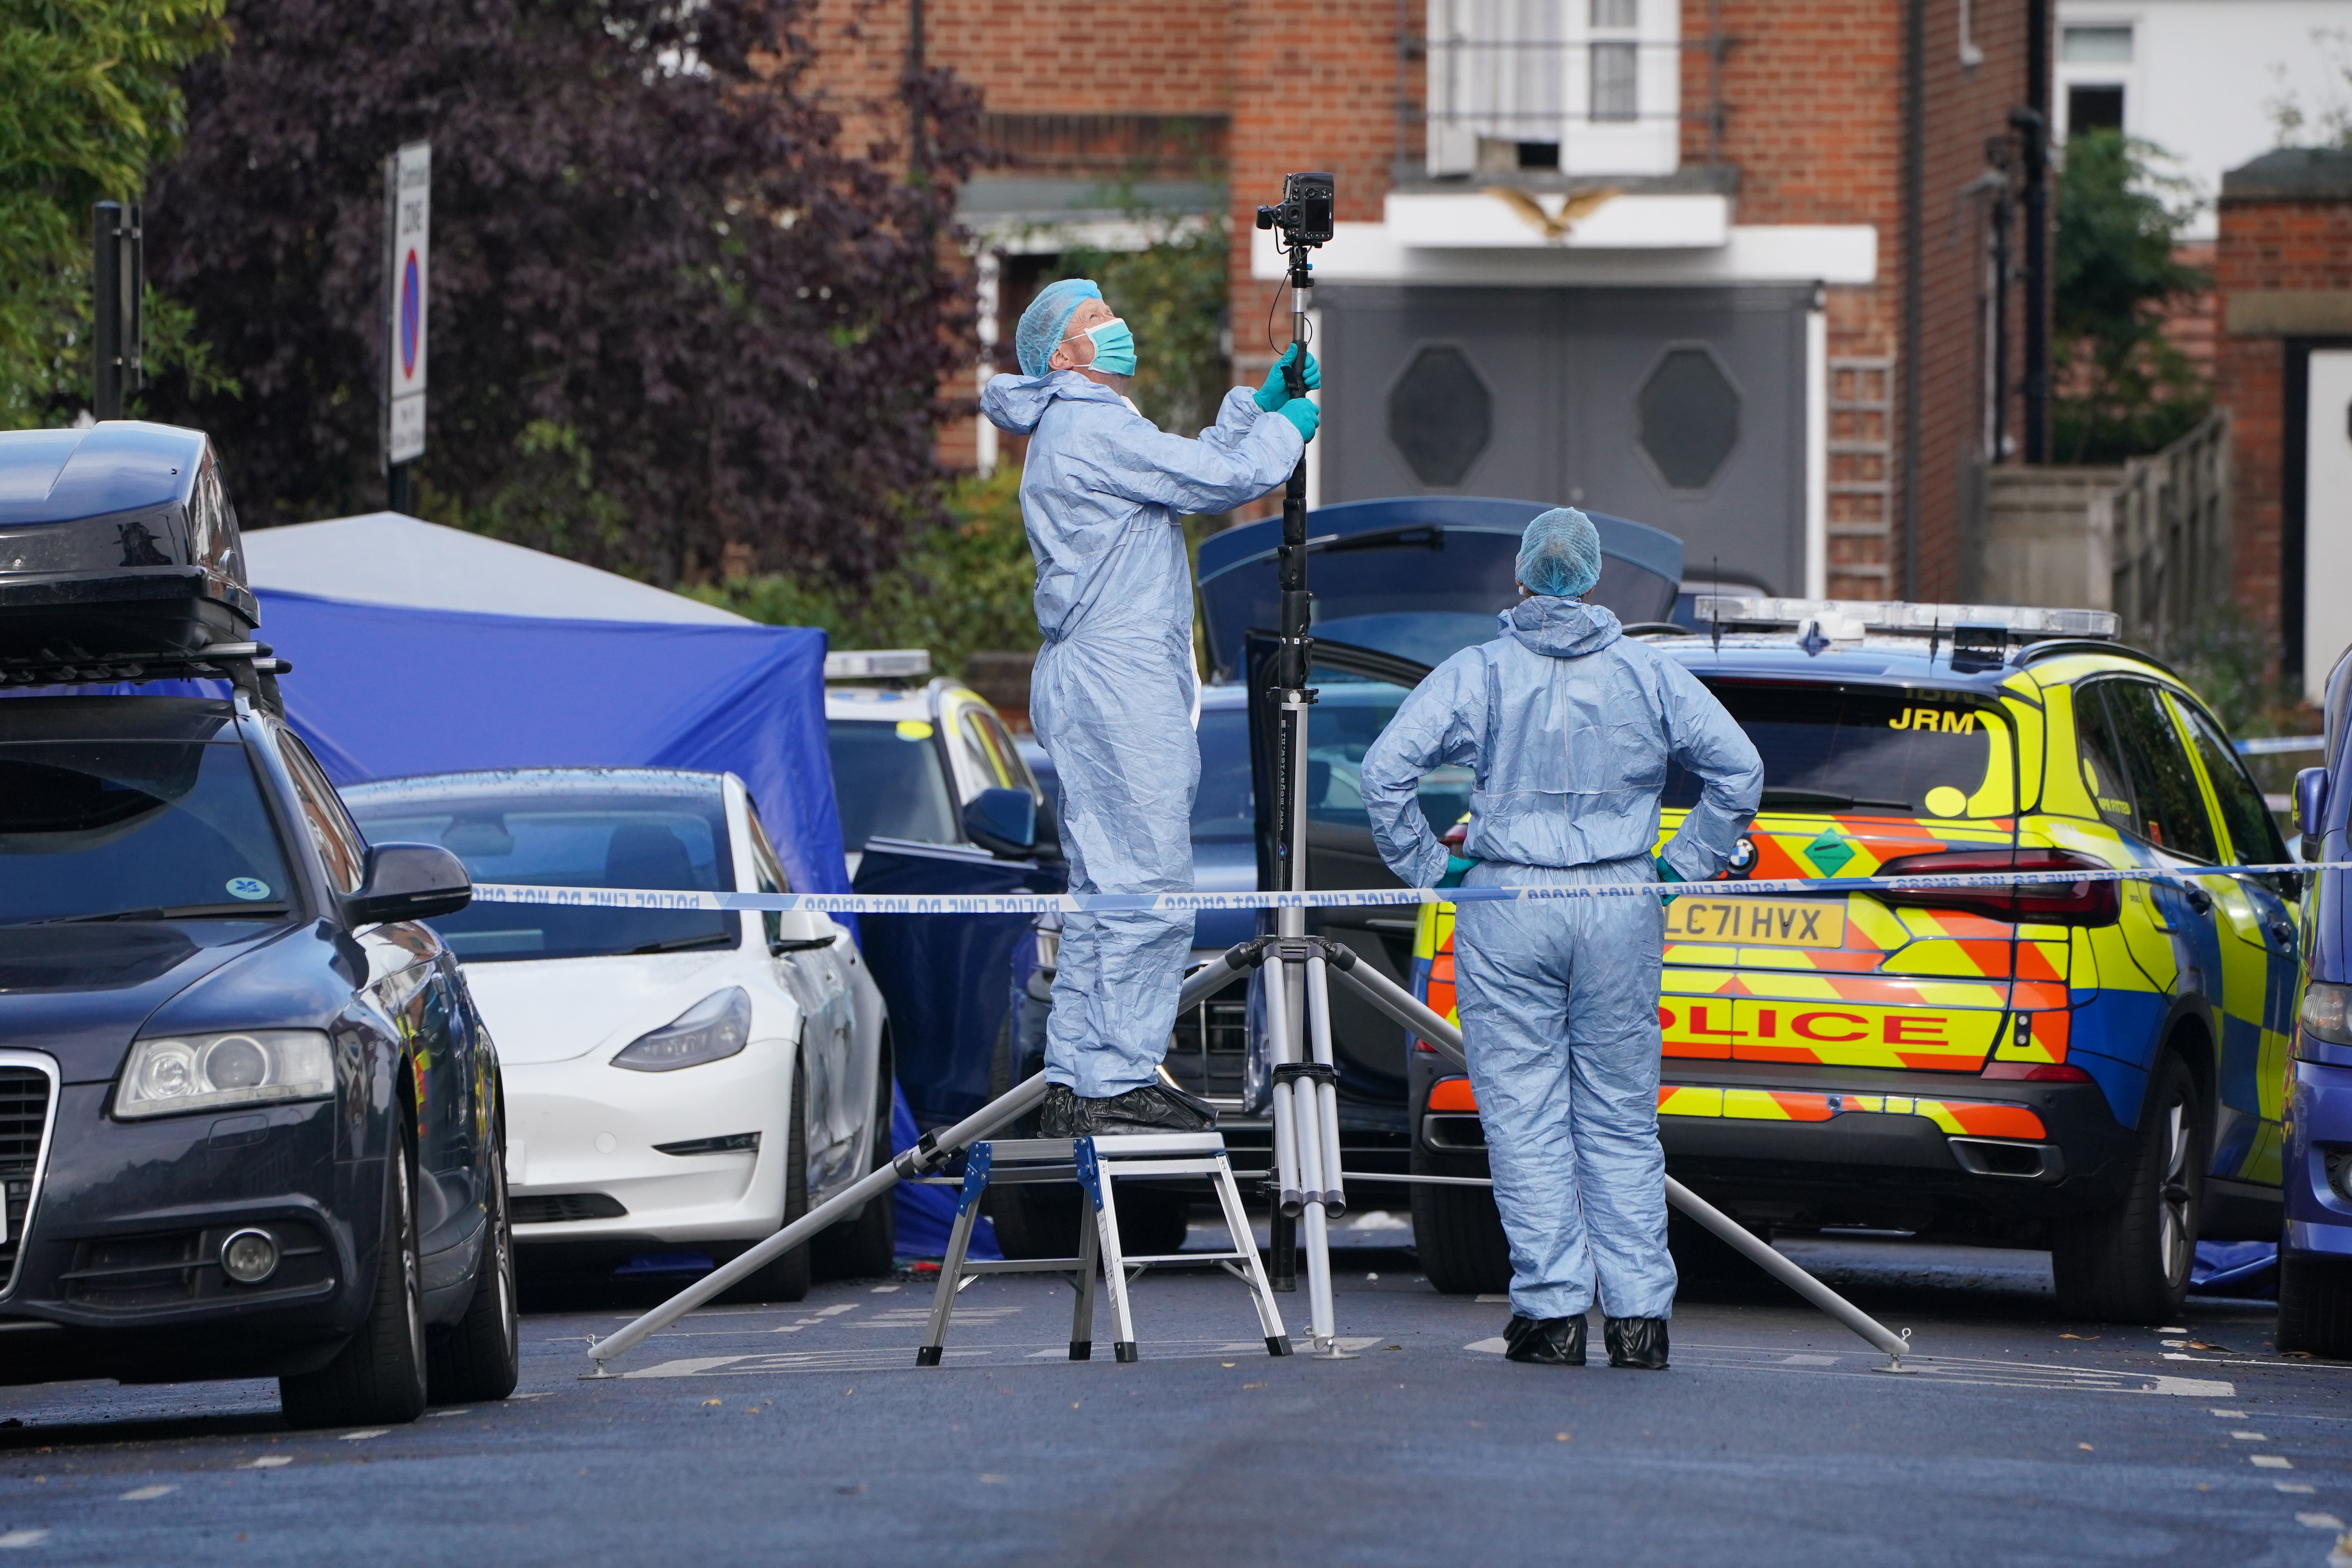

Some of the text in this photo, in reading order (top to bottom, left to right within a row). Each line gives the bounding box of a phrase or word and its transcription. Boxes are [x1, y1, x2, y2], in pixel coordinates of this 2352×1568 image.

[1889, 708, 1975, 735] JRM
[1664, 904, 1821, 940] LC71 HVX
[1660, 1006, 1949, 1046] LICE
